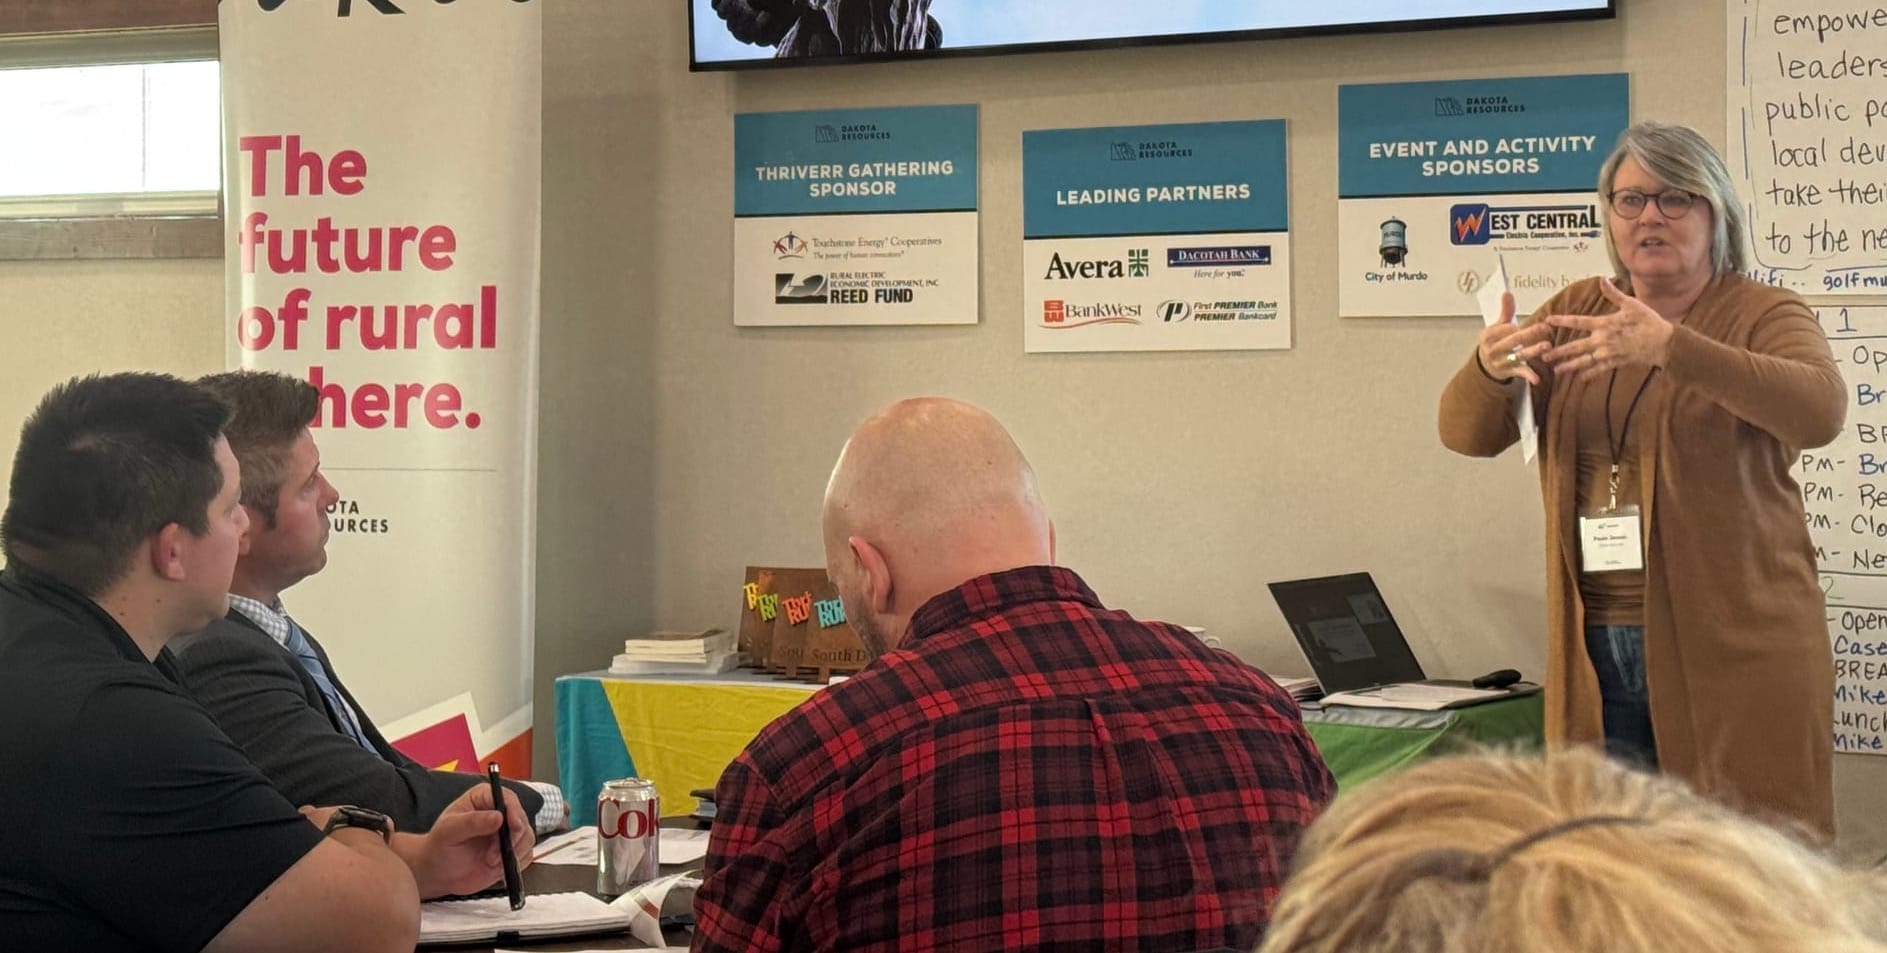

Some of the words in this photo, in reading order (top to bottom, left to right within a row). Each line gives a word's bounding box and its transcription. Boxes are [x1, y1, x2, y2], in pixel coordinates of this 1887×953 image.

[1466, 96, 1508, 105] DAKOTA
[1466, 104, 1526, 114] RESOURCES
[1766, 91, 1850, 136] public
[841, 124, 877, 133] DAKOTA
[841, 132, 891, 141] RESOURCES
[1139, 142, 1177, 150] DAKOTA
[1139, 149, 1192, 158] RESOURCES
[1369, 141, 1438, 158] EVENT
[1443, 139, 1489, 156] AND
[1495, 136, 1596, 154] ACTIVITY
[1771, 137, 1827, 167] local
[240, 135, 367, 196] The
[755, 164, 844, 181] THRIVERR
[848, 161, 954, 178] GATHERING
[1422, 158, 1540, 176] SPONSORS
[809, 181, 896, 197] SPONSOR
[1056, 188, 1140, 205] LEADING
[1146, 184, 1251, 202] PARTNERS
[1765, 178, 1823, 206] take
[1526, 205, 1602, 229] CENTRAL
[239, 212, 456, 273] future
[812, 238, 855, 248] Touchstone
[890, 236, 942, 248] Cooperatives
[1765, 221, 1791, 254] to
[1803, 219, 1850, 254] the
[1179, 250, 1228, 260] DACOTAH
[1230, 249, 1260, 259] BANK
[1044, 252, 1124, 279] Avera
[1194, 269, 1212, 278] Here
[1213, 269, 1225, 279] for
[1365, 272, 1384, 283] City
[1386, 271, 1396, 281] of
[1398, 270, 1428, 281] Murdo
[1513, 275, 1558, 288] fidelity
[830, 280, 870, 288] ECONOMIC
[830, 289, 869, 304] REED
[874, 288, 914, 304] FUND
[1065, 303, 1142, 318] BankWest
[1194, 302, 1212, 310] First
[1214, 301, 1256, 309] PREMIER
[238, 288, 312, 351] of
[326, 285, 497, 350] rural
[1194, 313, 1235, 321] PREMIER
[1238, 312, 1277, 320] Bankcard
[309, 366, 481, 429] here.
[334, 519, 388, 533] URCES
